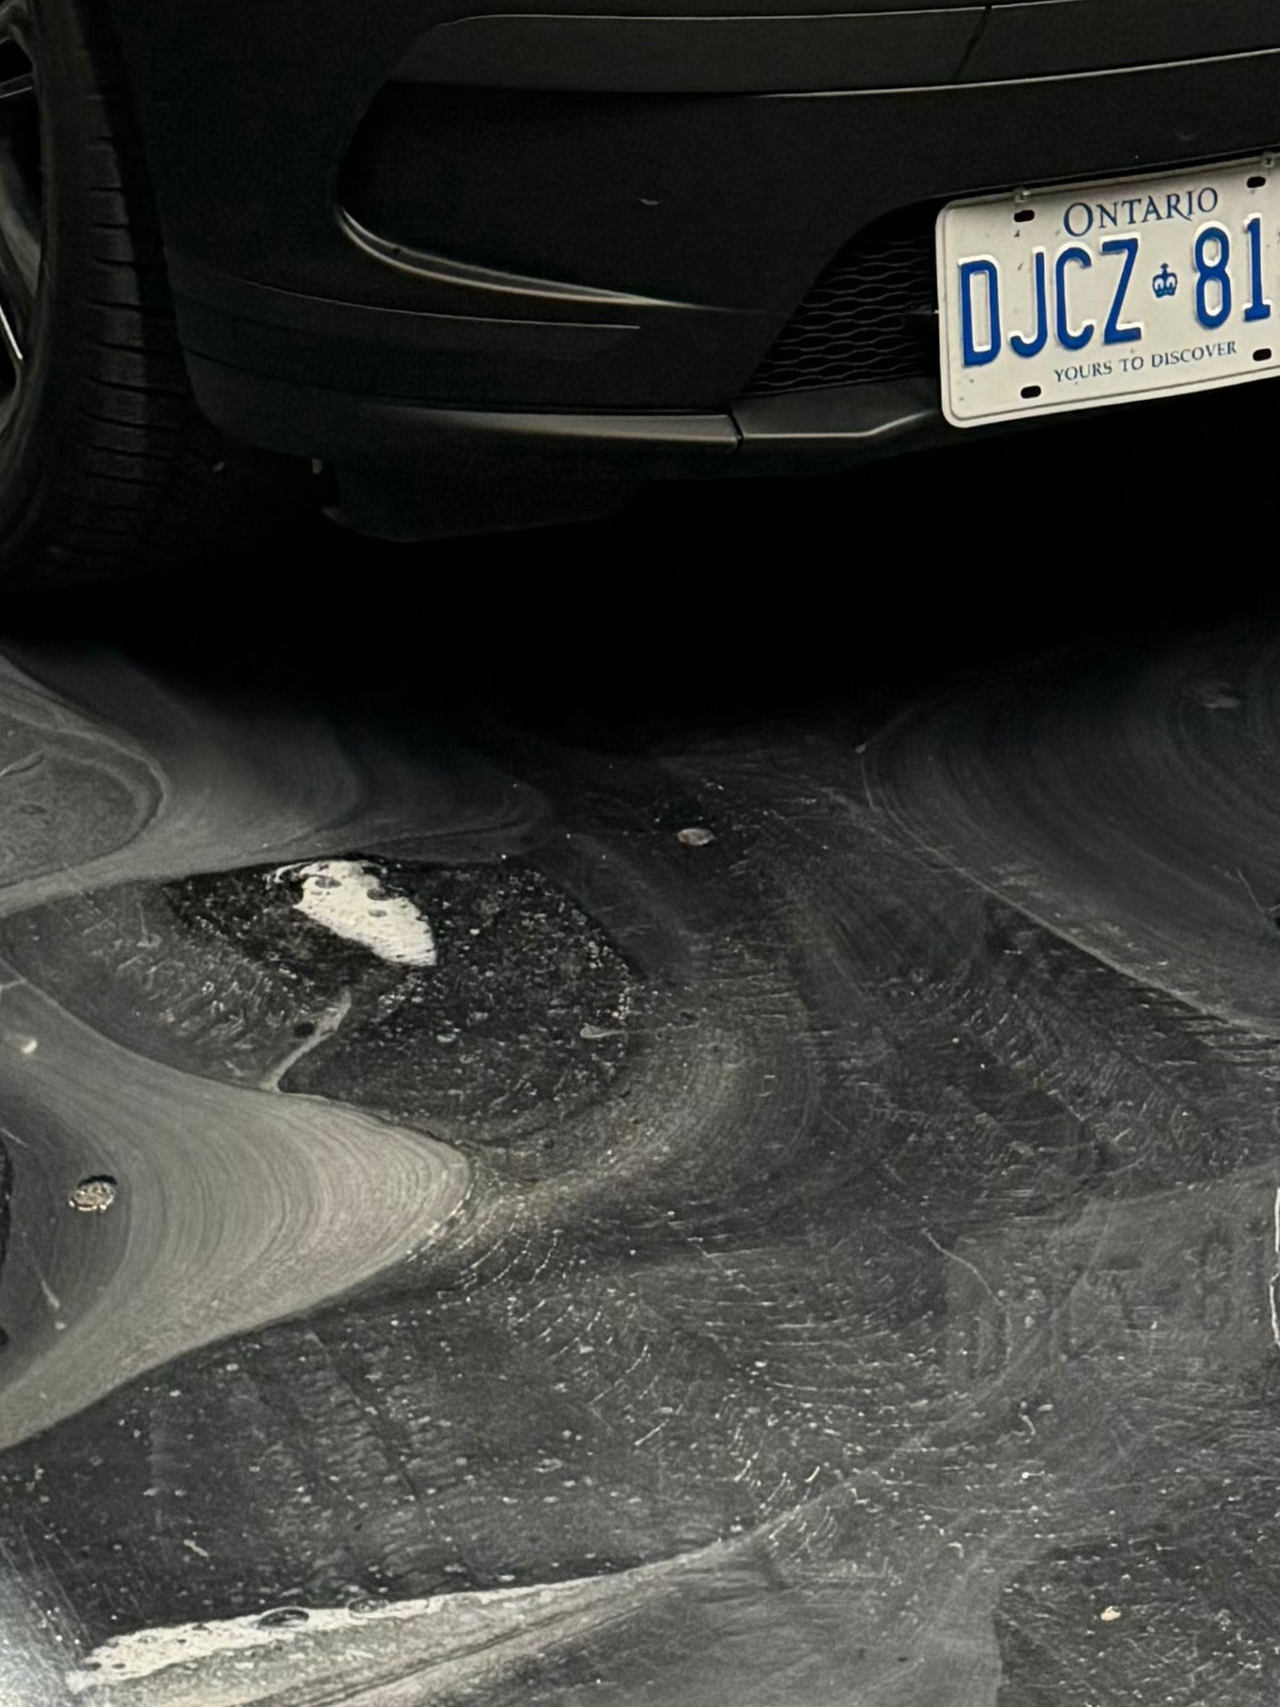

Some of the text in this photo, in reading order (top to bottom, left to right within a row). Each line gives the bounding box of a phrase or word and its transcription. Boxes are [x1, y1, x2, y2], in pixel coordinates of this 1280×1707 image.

[957, 233, 1144, 368] DJCZ
[1053, 340, 1238, 383] YOURS TO DISCOVER
